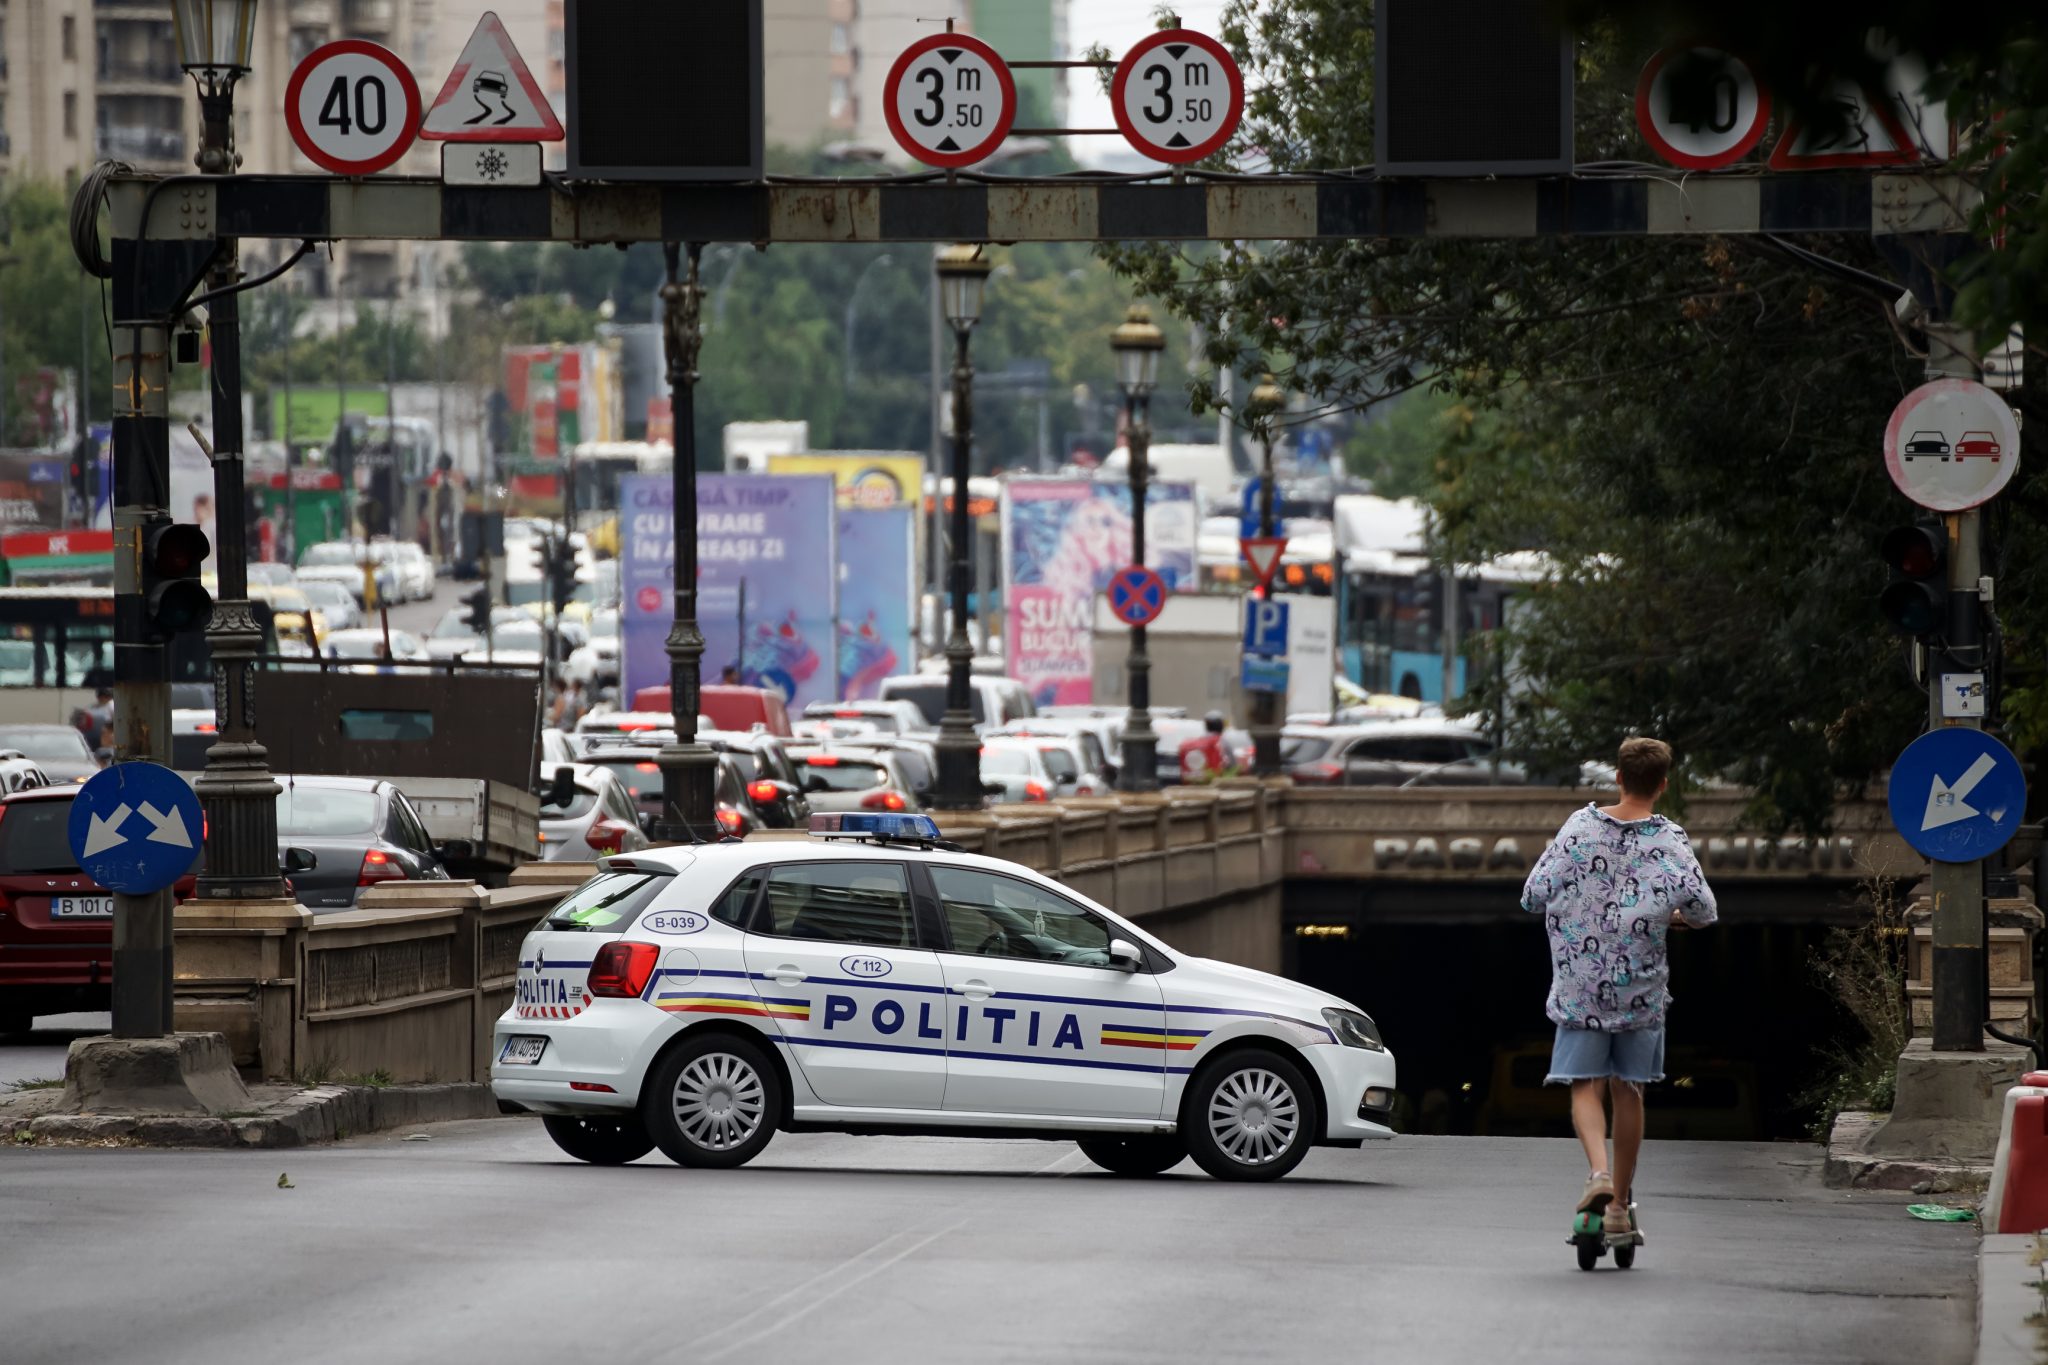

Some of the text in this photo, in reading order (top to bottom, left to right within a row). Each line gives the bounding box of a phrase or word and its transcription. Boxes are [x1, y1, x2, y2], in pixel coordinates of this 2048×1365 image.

[319, 75, 387, 136] 40
[914, 67, 981, 127] 3 m
[1142, 63, 1209, 124] 3 m
[633, 512, 665, 536] CU
[1254, 601, 1281, 646] P
[62, 899, 73, 914] B
[79, 899, 100, 914] 101
[655, 917, 695, 928] B-039
[862, 961, 882, 972] 112
[517, 979, 568, 1004] POLITIA
[823, 994, 1084, 1050] POLITIA
